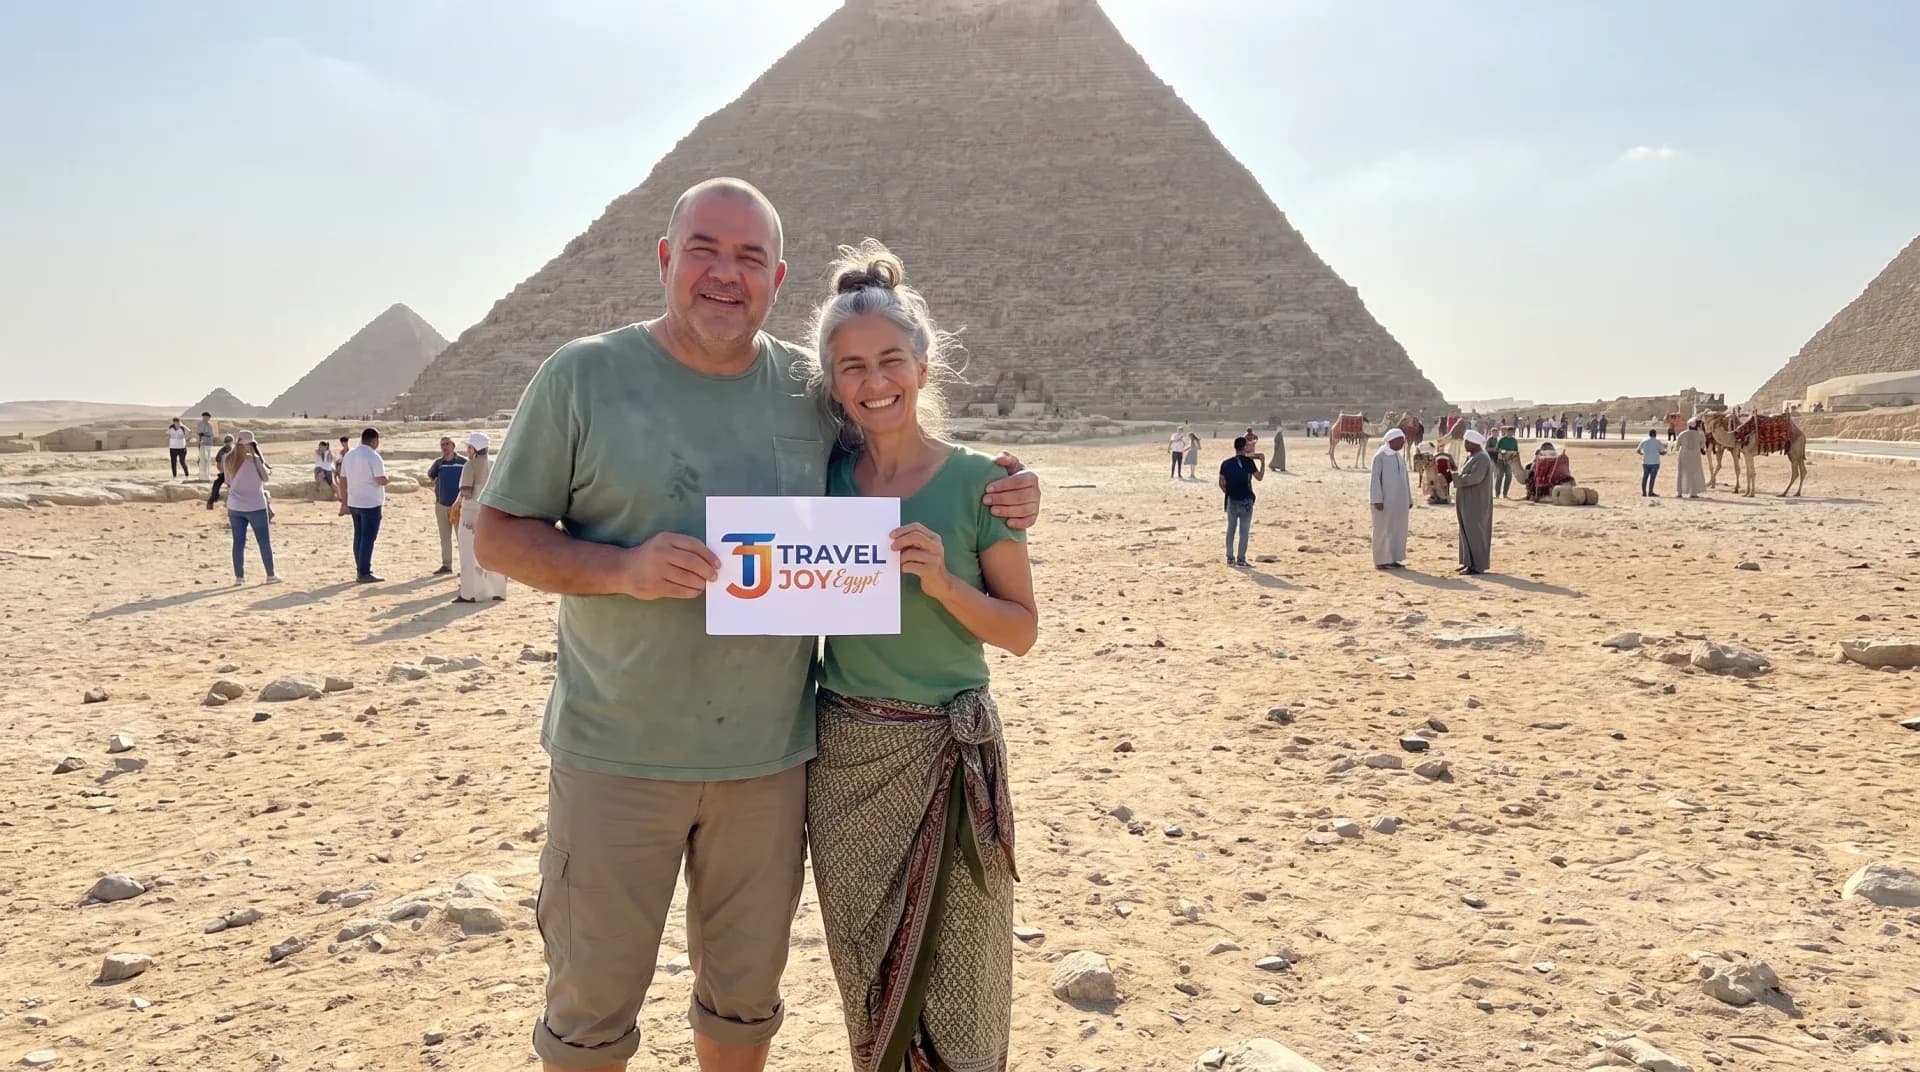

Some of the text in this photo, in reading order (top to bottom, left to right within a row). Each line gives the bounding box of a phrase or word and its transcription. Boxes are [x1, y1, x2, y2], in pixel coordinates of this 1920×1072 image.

[777, 544, 887, 564] TRAVEL
[778, 568, 883, 594] JOY Egypt
